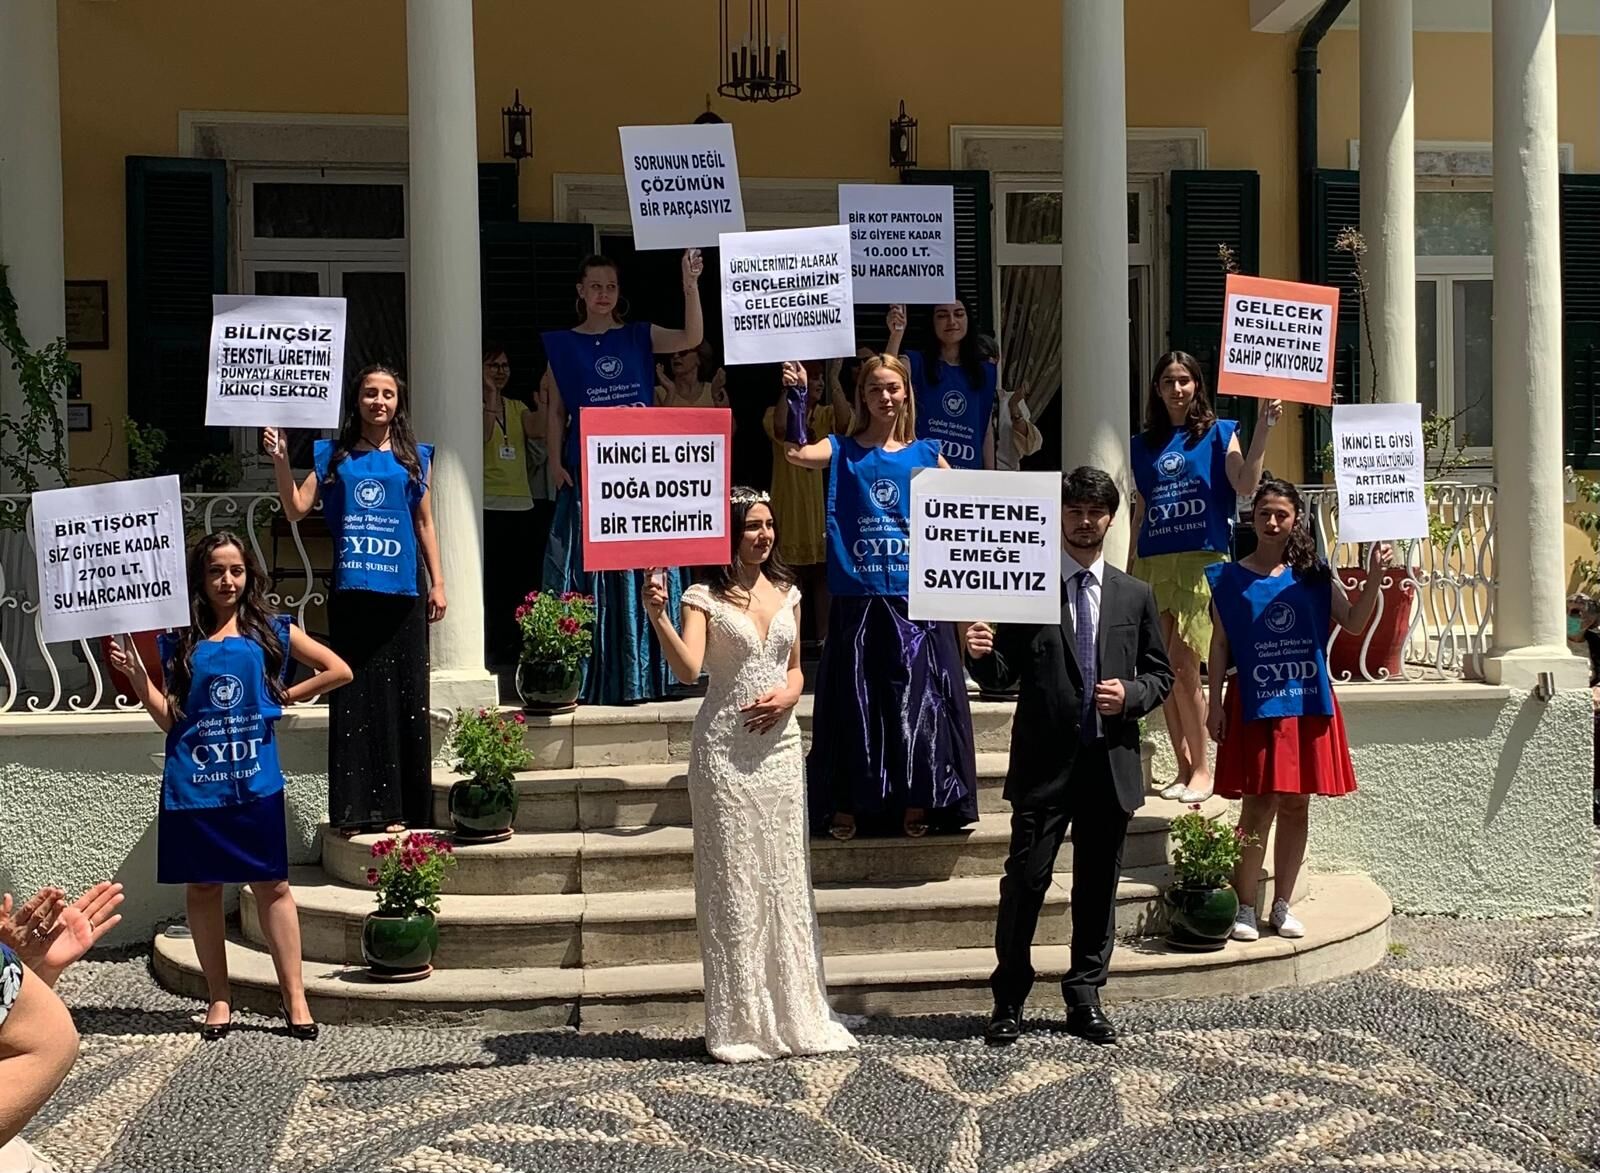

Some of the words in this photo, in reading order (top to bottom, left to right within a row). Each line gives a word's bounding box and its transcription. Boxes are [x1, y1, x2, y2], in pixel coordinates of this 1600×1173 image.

[634, 154, 689, 170] SORUNUN
[692, 150, 725, 168] DEĞİL
[641, 174, 724, 196] ÇÖZÜMÜN
[640, 199, 660, 216] BİR
[663, 199, 732, 219] PARÇASIYIZ
[849, 211, 865, 223] BİR
[869, 213, 888, 223] KOT
[891, 213, 942, 223] PANTOLON
[851, 229, 866, 240] SİZ
[870, 229, 905, 240] GİYENE
[909, 231, 941, 239] KADAR
[863, 247, 907, 257] 10.000
[912, 247, 930, 257] LT.
[730, 254, 797, 273] ÜRÜNLERİMİZİ
[801, 253, 838, 268] ALARAK
[851, 265, 866, 277] SU
[870, 264, 944, 277] HARCANIYOR
[733, 271, 839, 292] GENÇLERİMİZİN
[745, 292, 828, 310] GELECEĞİNE
[1236, 300, 1323, 321] GELECEK
[734, 314, 770, 331] DESTEK
[773, 308, 841, 328] OLUYORSUNUZ
[1235, 317, 1322, 335] NESİLLERİN
[225, 324, 332, 344] BİLİNÇSİZ
[1234, 333, 1320, 351] EMANETİNE
[223, 345, 274, 364] TEKSTİL
[279, 346, 330, 366] ÜRETİMİ
[1229, 347, 1261, 365] SAHİP
[1265, 352, 1323, 372] ÇIKIYORUZ
[221, 365, 270, 379] DÜNYAYI
[274, 367, 330, 381] KİRLETEN
[220, 381, 264, 396] İKİNCİ
[270, 384, 328, 398] SEKTÖR
[939, 440, 974, 460] YDD
[1342, 433, 1372, 449] İKİNCİ
[1375, 436, 1385, 448] EL
[1389, 432, 1413, 448] GİYSİ
[597, 442, 646, 464] İKİNCİ
[652, 446, 670, 463] EL
[675, 441, 714, 463] GİYSİ
[1344, 455, 1375, 470] PAYLAŞIM
[602, 477, 650, 499] DOĞA
[656, 480, 711, 497] DOSTU
[1356, 474, 1405, 485] ARTTIRAN
[1349, 491, 1364, 505] BİR
[1367, 488, 1414, 504] TERCİHTİR
[601, 513, 627, 534] BİR
[632, 510, 712, 533] TERCİHTİR
[925, 499, 1046, 525] ÜRETENE,
[1148, 499, 1206, 526] ÇYDD
[55, 520, 86, 537] BİR
[92, 512, 159, 533] TİŞÖRT
[925, 525, 1046, 547] ÜRETİLENE,
[49, 545, 69, 563] SİZ
[73, 541, 120, 560] GİYENE
[125, 535, 169, 553] KADAR
[950, 547, 1020, 563] EMEĞE
[79, 566, 116, 581] 2700
[122, 563, 143, 575] LT.
[339, 560, 362, 568] MİR
[366, 563, 398, 573] ŞUBESİ
[924, 569, 1046, 591] SAYGILIYIZ
[55, 593, 72, 609] SU
[78, 581, 171, 607] HARCANIYOR
[1253, 661, 1317, 687] ÇYDD
[1257, 688, 1287, 698] İZMİR
[1289, 686, 1318, 697] ŞUBESİ
[192, 771, 228, 783] İZMİR
